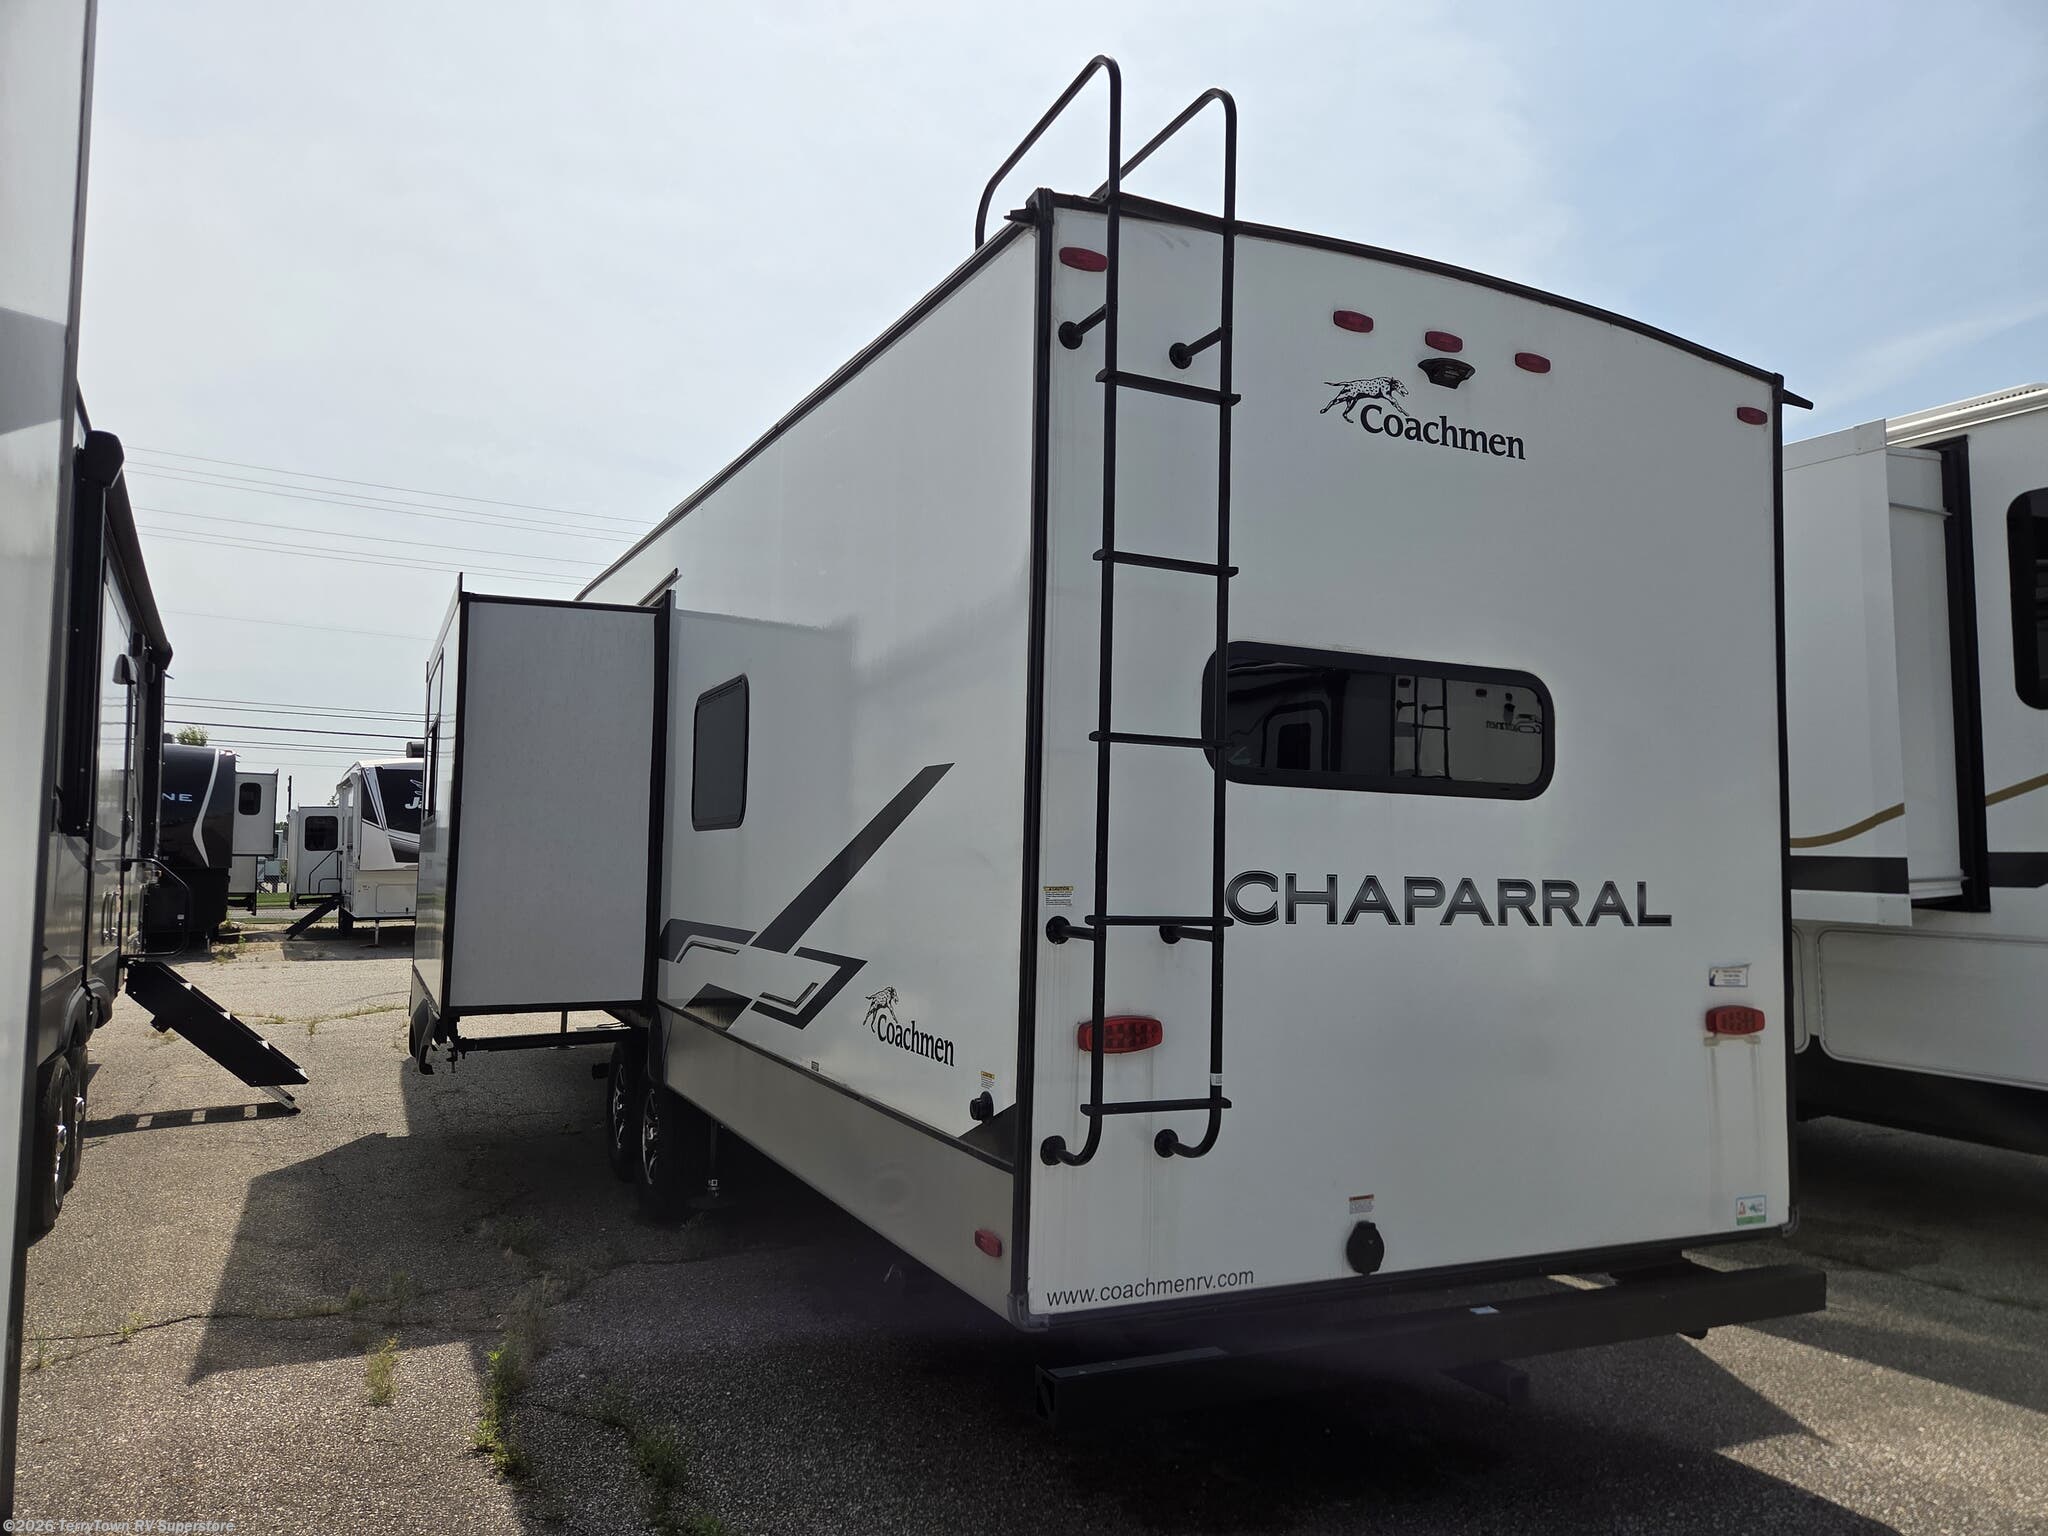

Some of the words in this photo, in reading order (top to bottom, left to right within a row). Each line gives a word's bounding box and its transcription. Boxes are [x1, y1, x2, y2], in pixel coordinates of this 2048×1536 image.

[1360, 404, 1526, 460] Coachmen
[1225, 870, 1672, 927] CHAPARRAL
[877, 1014, 955, 1067] Coachmen
[1047, 1270, 1254, 1306] www.coachmenrv.com
